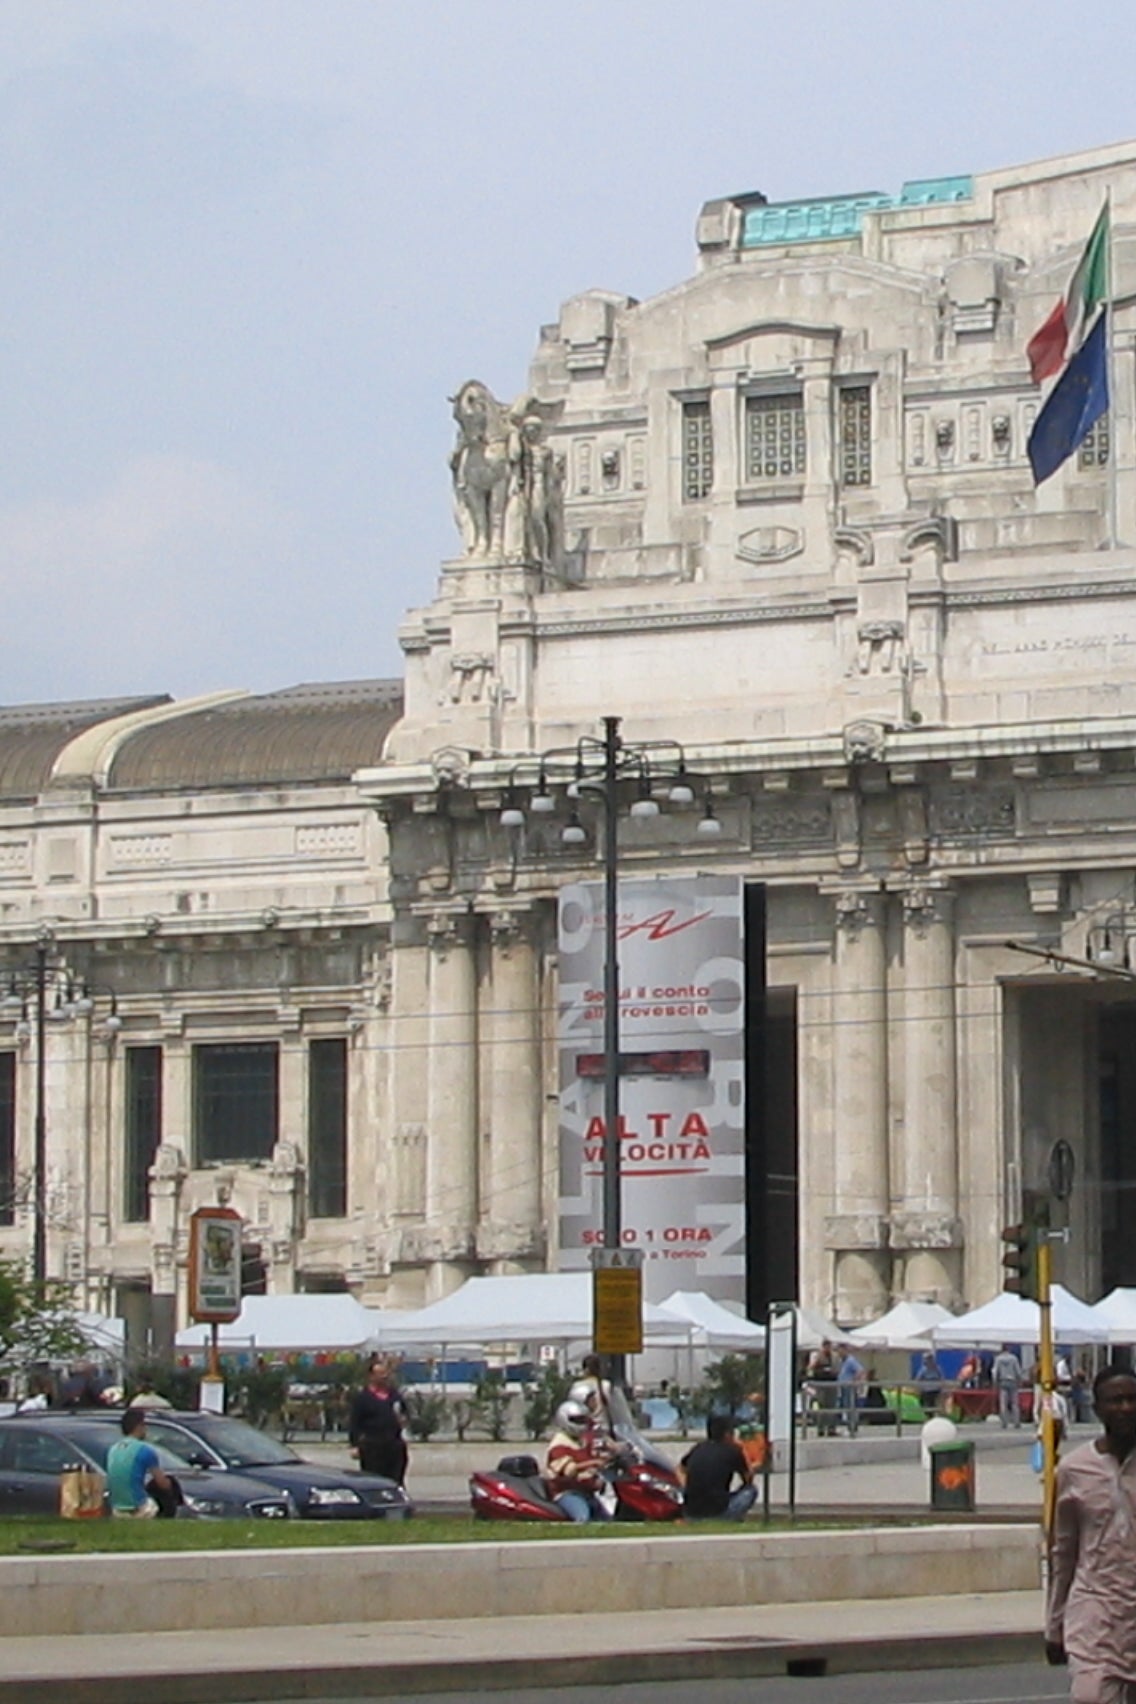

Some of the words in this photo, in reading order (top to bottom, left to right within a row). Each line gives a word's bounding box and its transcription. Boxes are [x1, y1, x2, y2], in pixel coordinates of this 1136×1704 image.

[583, 988, 630, 1003] Seui
[637, 986, 646, 998] il
[652, 984, 710, 998] conto
[621, 1004, 708, 1017] rovescia
[585, 1112, 709, 1141] ALTA
[582, 1229, 636, 1244] SOO
[645, 1230, 653, 1242] 1
[663, 1228, 712, 1242] ORA
[662, 1249, 706, 1260] Torino
